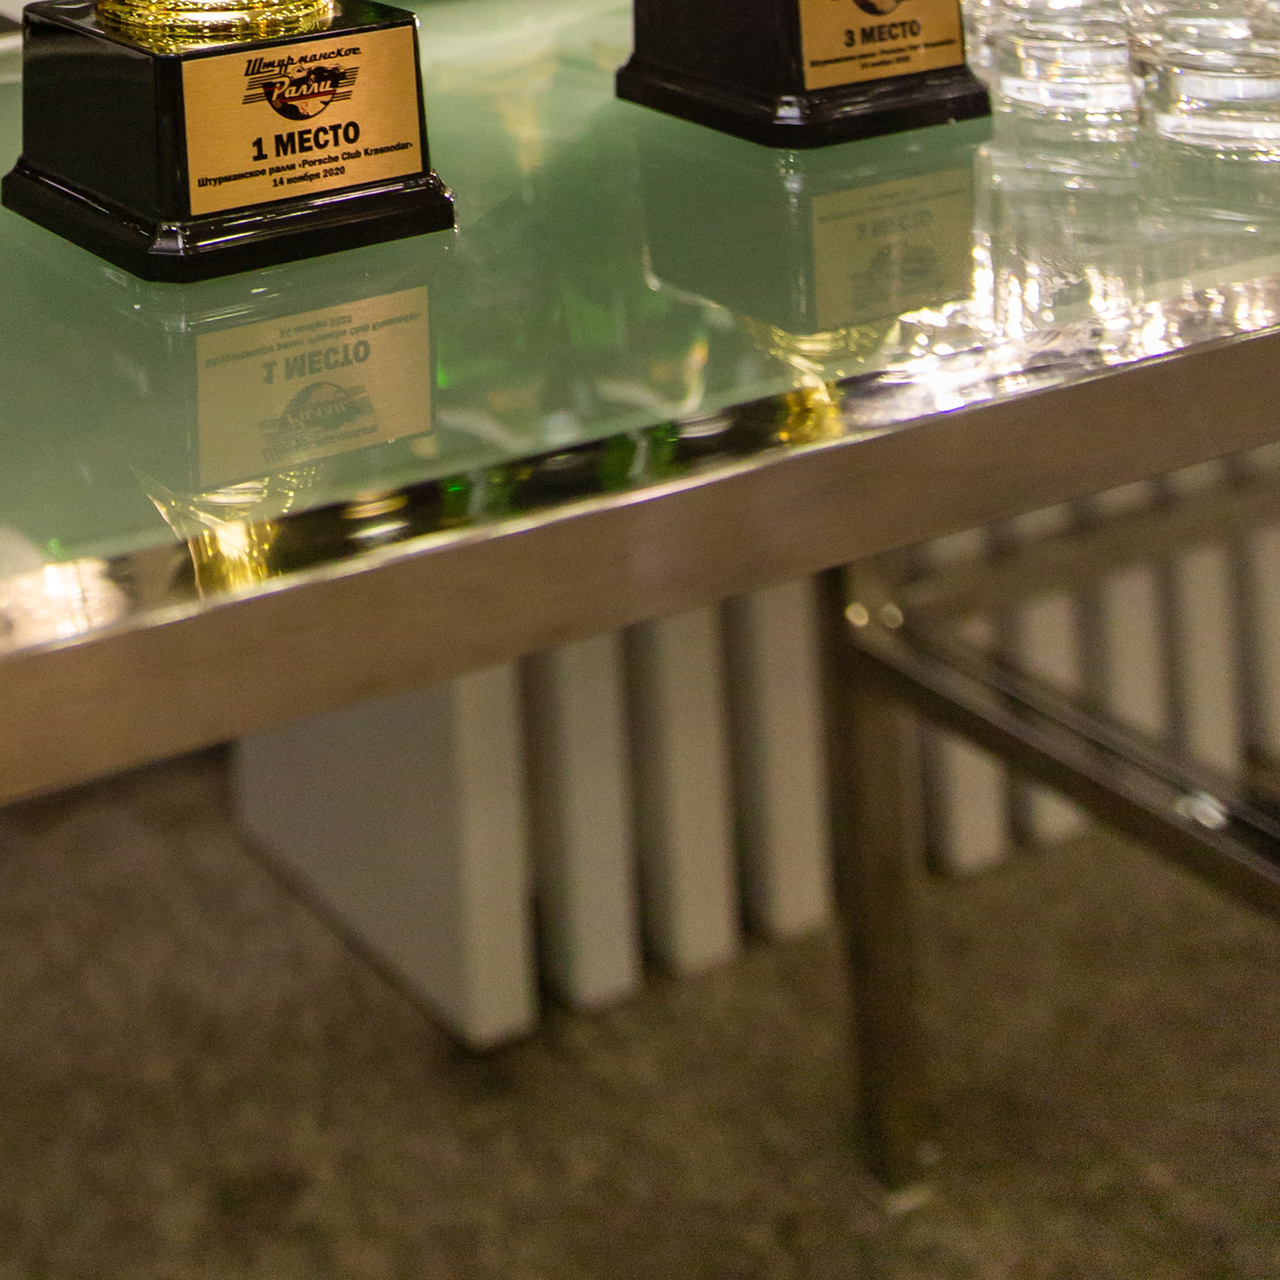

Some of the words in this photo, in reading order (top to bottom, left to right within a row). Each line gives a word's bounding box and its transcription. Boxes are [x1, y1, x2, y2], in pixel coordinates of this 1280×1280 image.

[844, 29, 856, 48] 3
[860, 19, 922, 44] МЕСТО
[243, 46, 362, 77] Штурманское
[271, 75, 333, 102] Ралли
[251, 137, 268, 162] 1
[274, 121, 361, 158] МЕСТО
[197, 168, 268, 188] Штурманское
[268, 163, 296, 176] ралли
[341, 149, 362, 161] Club
[272, 176, 285, 188] 14
[286, 171, 321, 183] ноября
[322, 165, 346, 178] 2020
